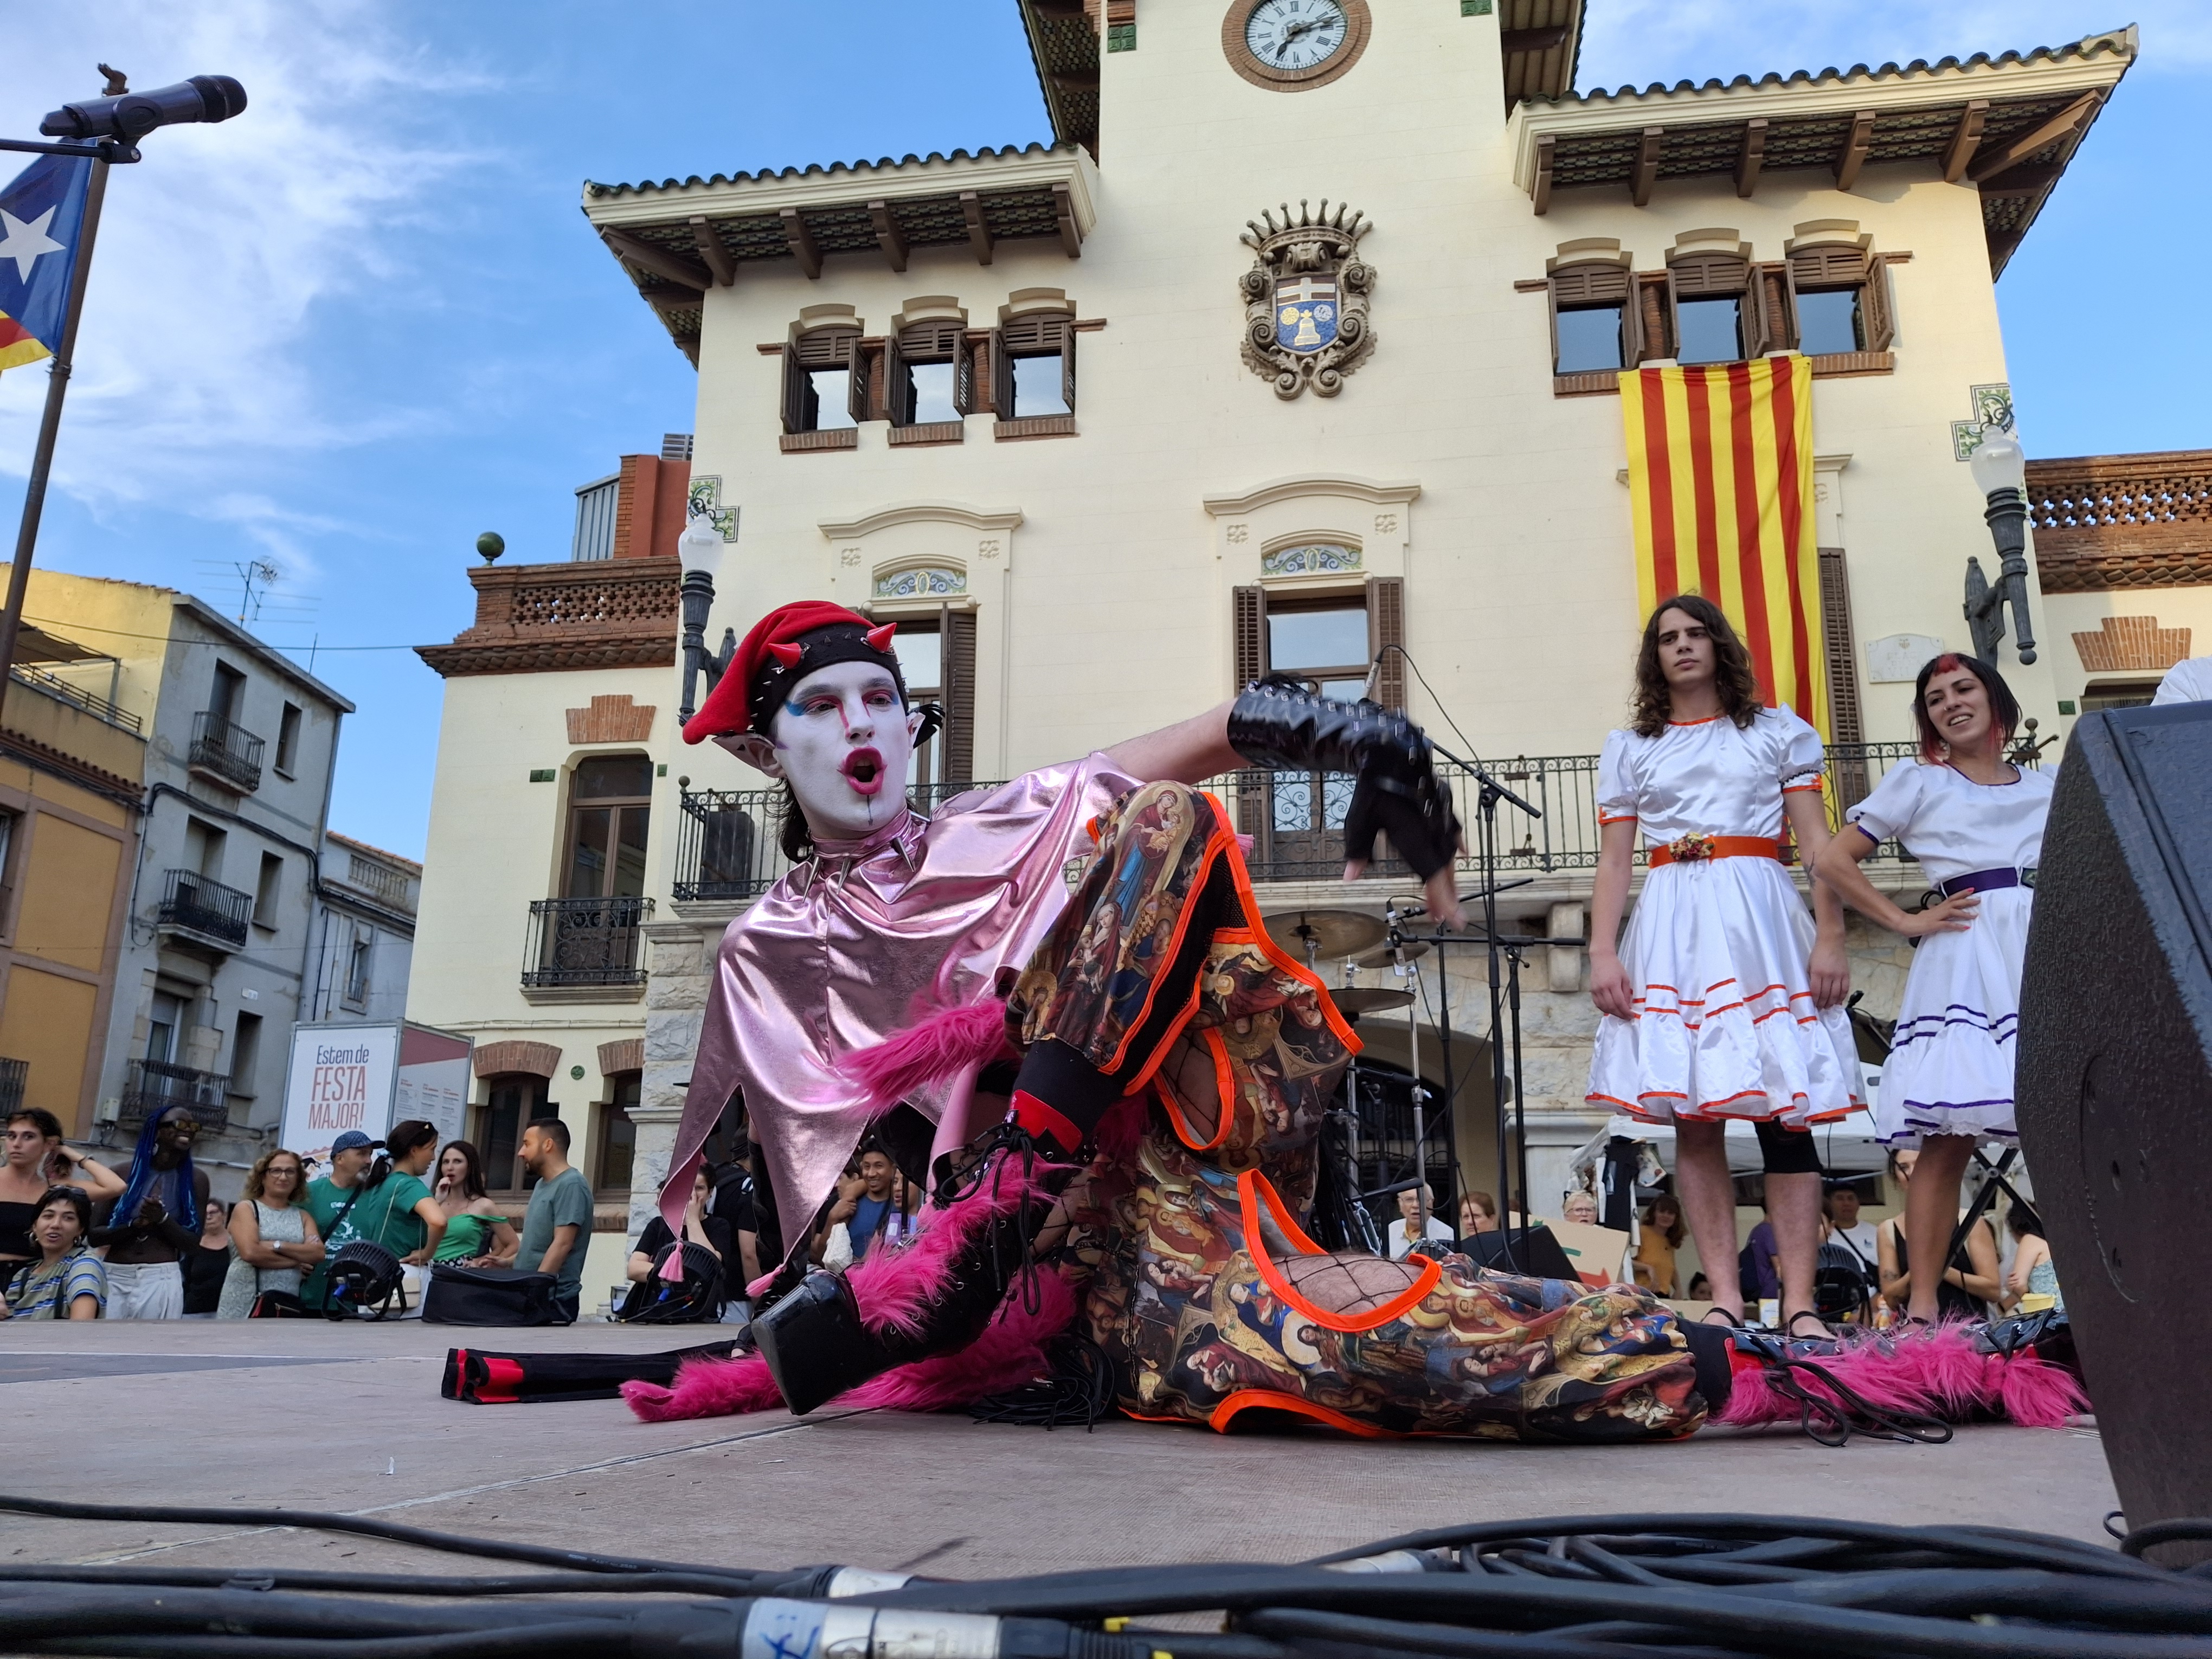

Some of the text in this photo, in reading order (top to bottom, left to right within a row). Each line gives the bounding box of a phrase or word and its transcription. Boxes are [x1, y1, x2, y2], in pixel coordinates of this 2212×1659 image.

[316, 1044, 369, 1064] Estem de
[311, 1066, 365, 1102] FESTA
[308, 1102, 365, 1129] MAJOR!
